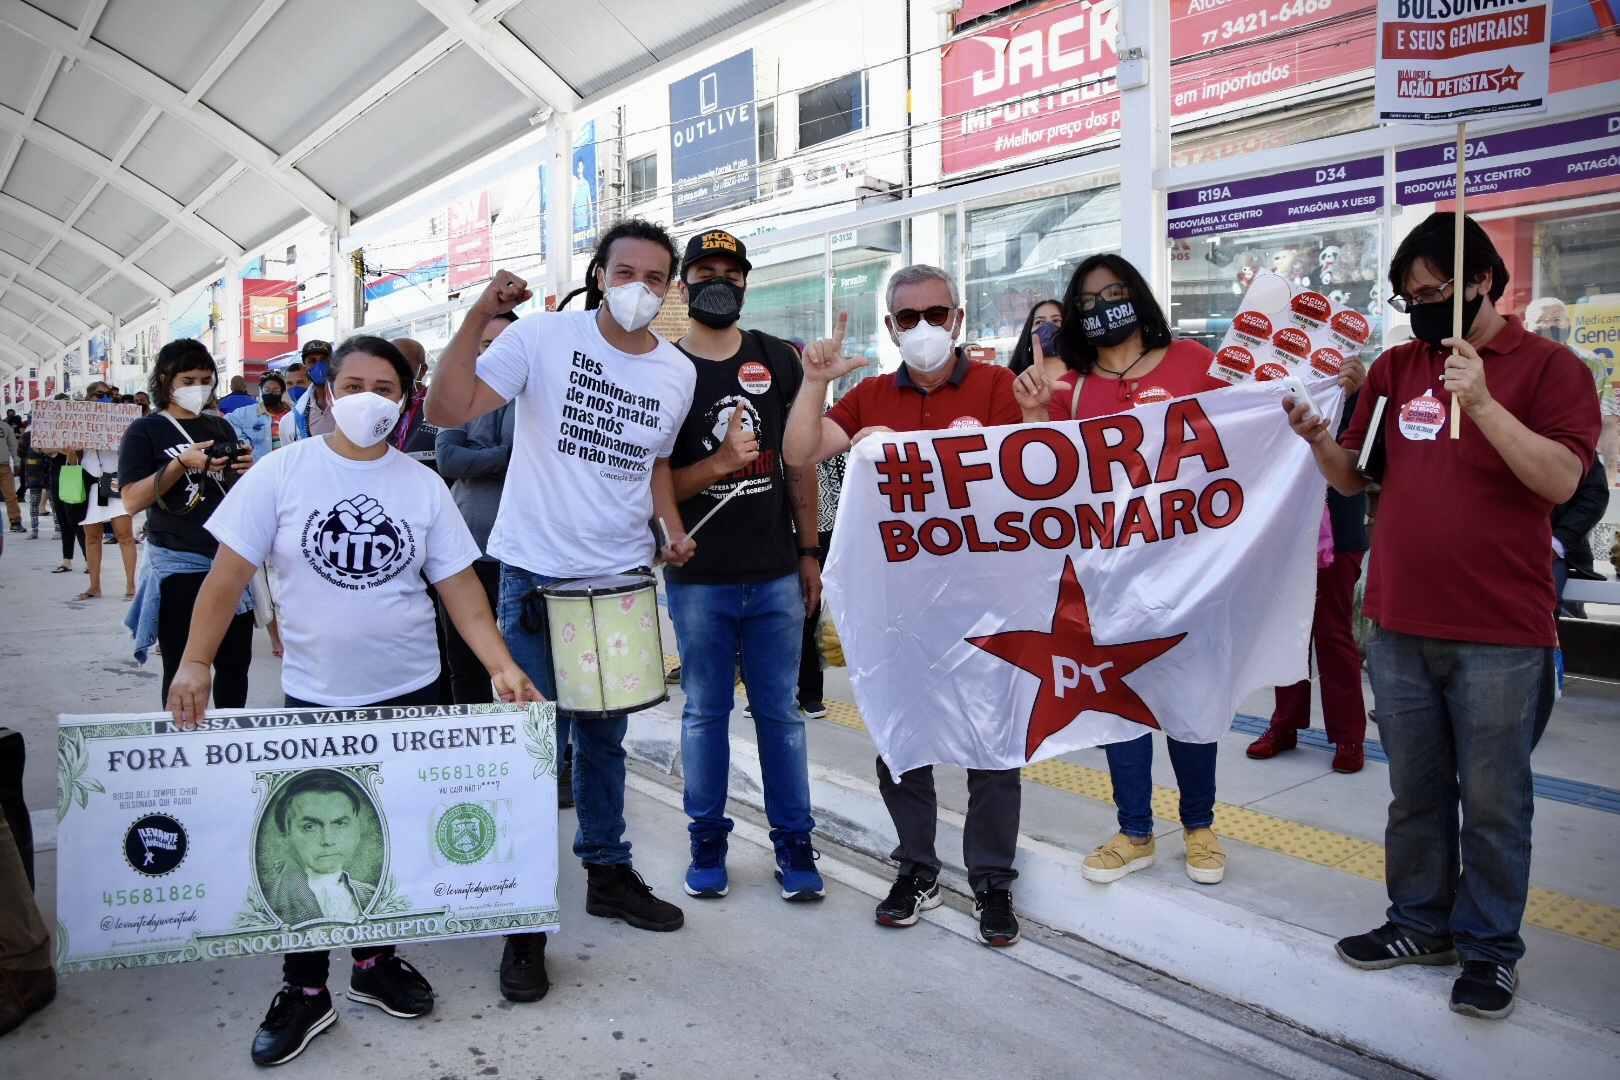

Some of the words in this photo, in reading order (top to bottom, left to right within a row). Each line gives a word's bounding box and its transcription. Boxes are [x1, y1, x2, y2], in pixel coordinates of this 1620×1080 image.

[1397, 30, 1405, 50] E
[1409, 30, 1445, 51] SEUS
[1449, 13, 1529, 47] GENERAIS!
[1174, 90, 1198, 106] em
[1201, 63, 1291, 100] importados
[1399, 77, 1434, 99] AÇÃO
[1436, 73, 1489, 97] PETISTA
[1501, 75, 1517, 86] PT
[673, 104, 749, 148] OUTLIVE
[994, 127, 1044, 152] #Melhor
[1047, 119, 1081, 143] preço
[1085, 110, 1108, 129] dos
[1443, 141, 1488, 161] R9A
[1198, 185, 1232, 203] R19A
[1315, 166, 1347, 183] D34
[1404, 176, 1471, 195] RODOVIÁRA
[1473, 174, 1482, 184] X
[1484, 166, 1532, 182] CENTRO
[1433, 190, 1449, 199] (VIA
[1466, 183, 1498, 193] HELENA)
[1169, 215, 1219, 231] RODOVIÁRIA
[1220, 213, 1227, 223] X
[1228, 209, 1263, 222] CENTRO
[1288, 200, 1340, 216] PATAGÔNIA
[1341, 199, 1349, 208] X
[1350, 195, 1376, 207] UESB
[1105, 302, 1135, 322] FORA
[1301, 294, 1327, 307] VACINA
[1081, 315, 1102, 330] ORA
[1243, 313, 1269, 326] VACINA
[1336, 321, 1361, 337] COMIDA
[1341, 313, 1366, 328] VACINA
[1279, 339, 1304, 353] COMIDA
[1282, 330, 1308, 344] VACINA
[572, 350, 604, 376] Eles
[1226, 348, 1251, 360] VACINA
[569, 370, 660, 412] combinaram
[32, 411, 63, 420] FALSOS
[35, 400, 62, 411] FORA
[65, 401, 92, 412] BOZO
[95, 402, 142, 415] MILICIANO
[566, 387, 585, 404] de
[586, 394, 615, 414] nos
[616, 405, 662, 432] matar,
[1408, 411, 1438, 419] COMIDA
[1411, 400, 1440, 409] VACINA
[562, 404, 595, 426] mas
[596, 416, 625, 435] nós
[557, 438, 576, 455] de
[578, 445, 606, 464] não
[560, 421, 650, 459] combinamos
[875, 397, 1230, 513] #FORA
[301, 508, 321, 548] Movimento
[878, 477, 1244, 562] BOLSONARO
[302, 549, 312, 559] de
[321, 530, 396, 571] MTD
[308, 557, 359, 590] Trabalhadoras
[366, 557, 413, 589] Trabalhadores
[1051, 655, 1114, 698] PT
[250, 712, 303, 728] VIDA
[312, 710, 369, 724] VALE
[374, 709, 384, 720] 1
[107, 745, 190, 773] FORA
[205, 733, 379, 766] BOLSONARO
[392, 725, 517, 752] URGENTE
[418, 761, 509, 782] 45681826
[112, 791, 134, 800] BOLSO
[136, 790, 150, 799] DELE
[153, 788, 177, 798] SEMPRE
[180, 787, 198, 796] CHEIO
[119, 799, 157, 810] BOLSONADA
[159, 798, 170, 807] QUE
[140, 827, 179, 842] LEVANTE
[102, 883, 206, 907] 45681826
[207, 918, 440, 958] GENOCIDA&CORRUPTO
